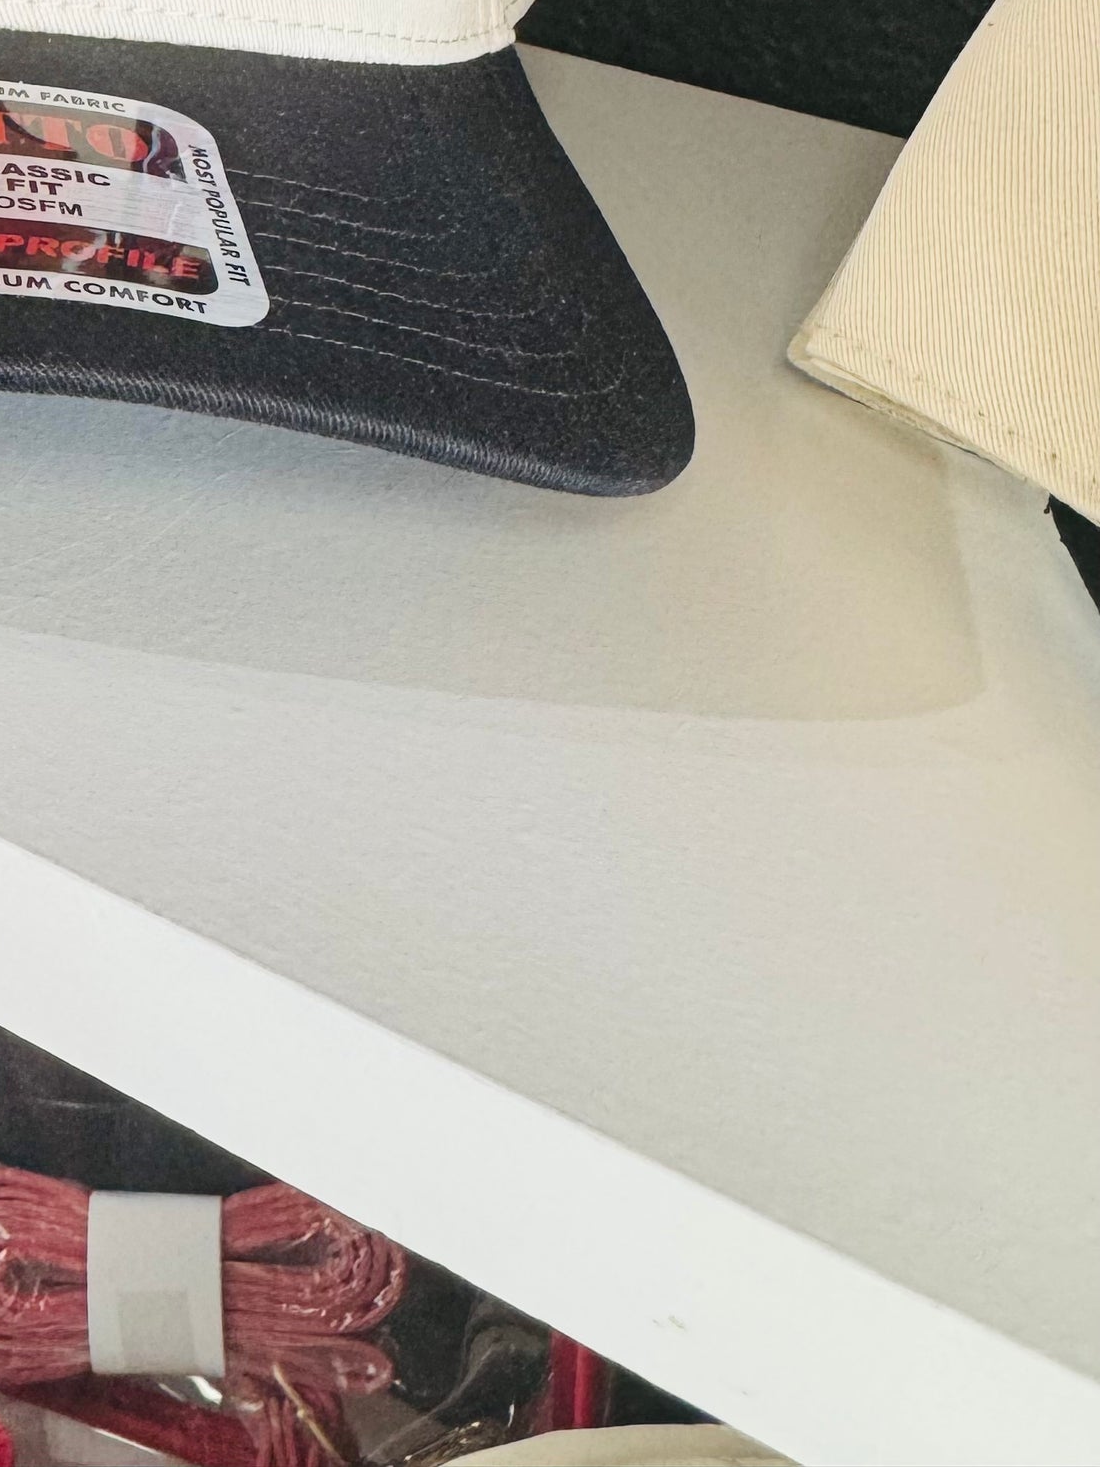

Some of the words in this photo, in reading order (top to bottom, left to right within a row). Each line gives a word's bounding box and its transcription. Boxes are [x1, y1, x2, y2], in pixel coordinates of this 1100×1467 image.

[40, 91, 127, 113] FABRIC
[188, 144, 218, 188] MOST
[6, 178, 63, 196] FIT
[201, 187, 241, 260] POPULAR
[224, 262, 251, 287] FIT
[64, 279, 208, 315] COMFORT
